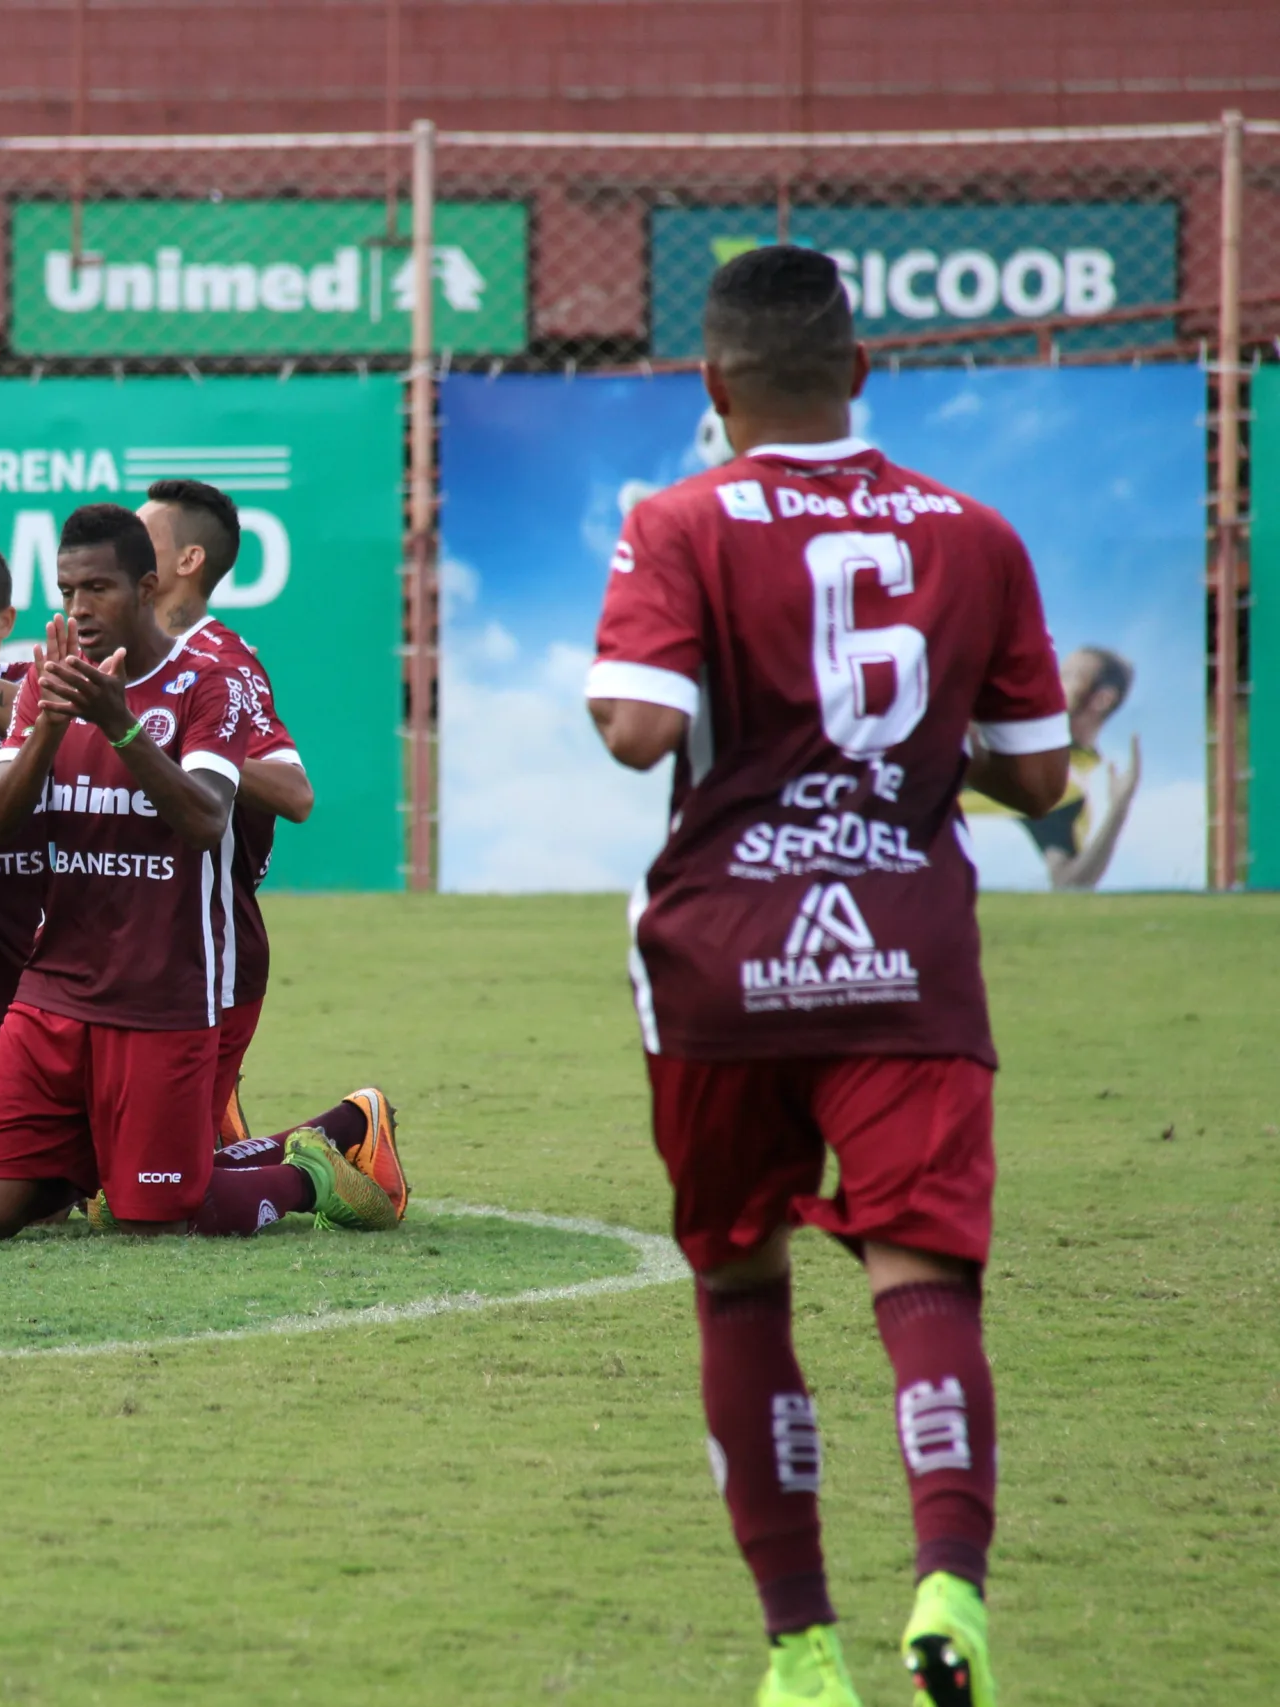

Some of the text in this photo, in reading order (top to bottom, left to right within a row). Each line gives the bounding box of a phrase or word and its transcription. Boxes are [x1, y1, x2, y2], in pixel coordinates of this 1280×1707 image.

[45, 247, 361, 312] Unimed
[776, 487, 848, 518] Doe
[804, 531, 928, 762] 6
[55, 850, 175, 880] BANESTES
[741, 947, 918, 989] ILHA AZUL
